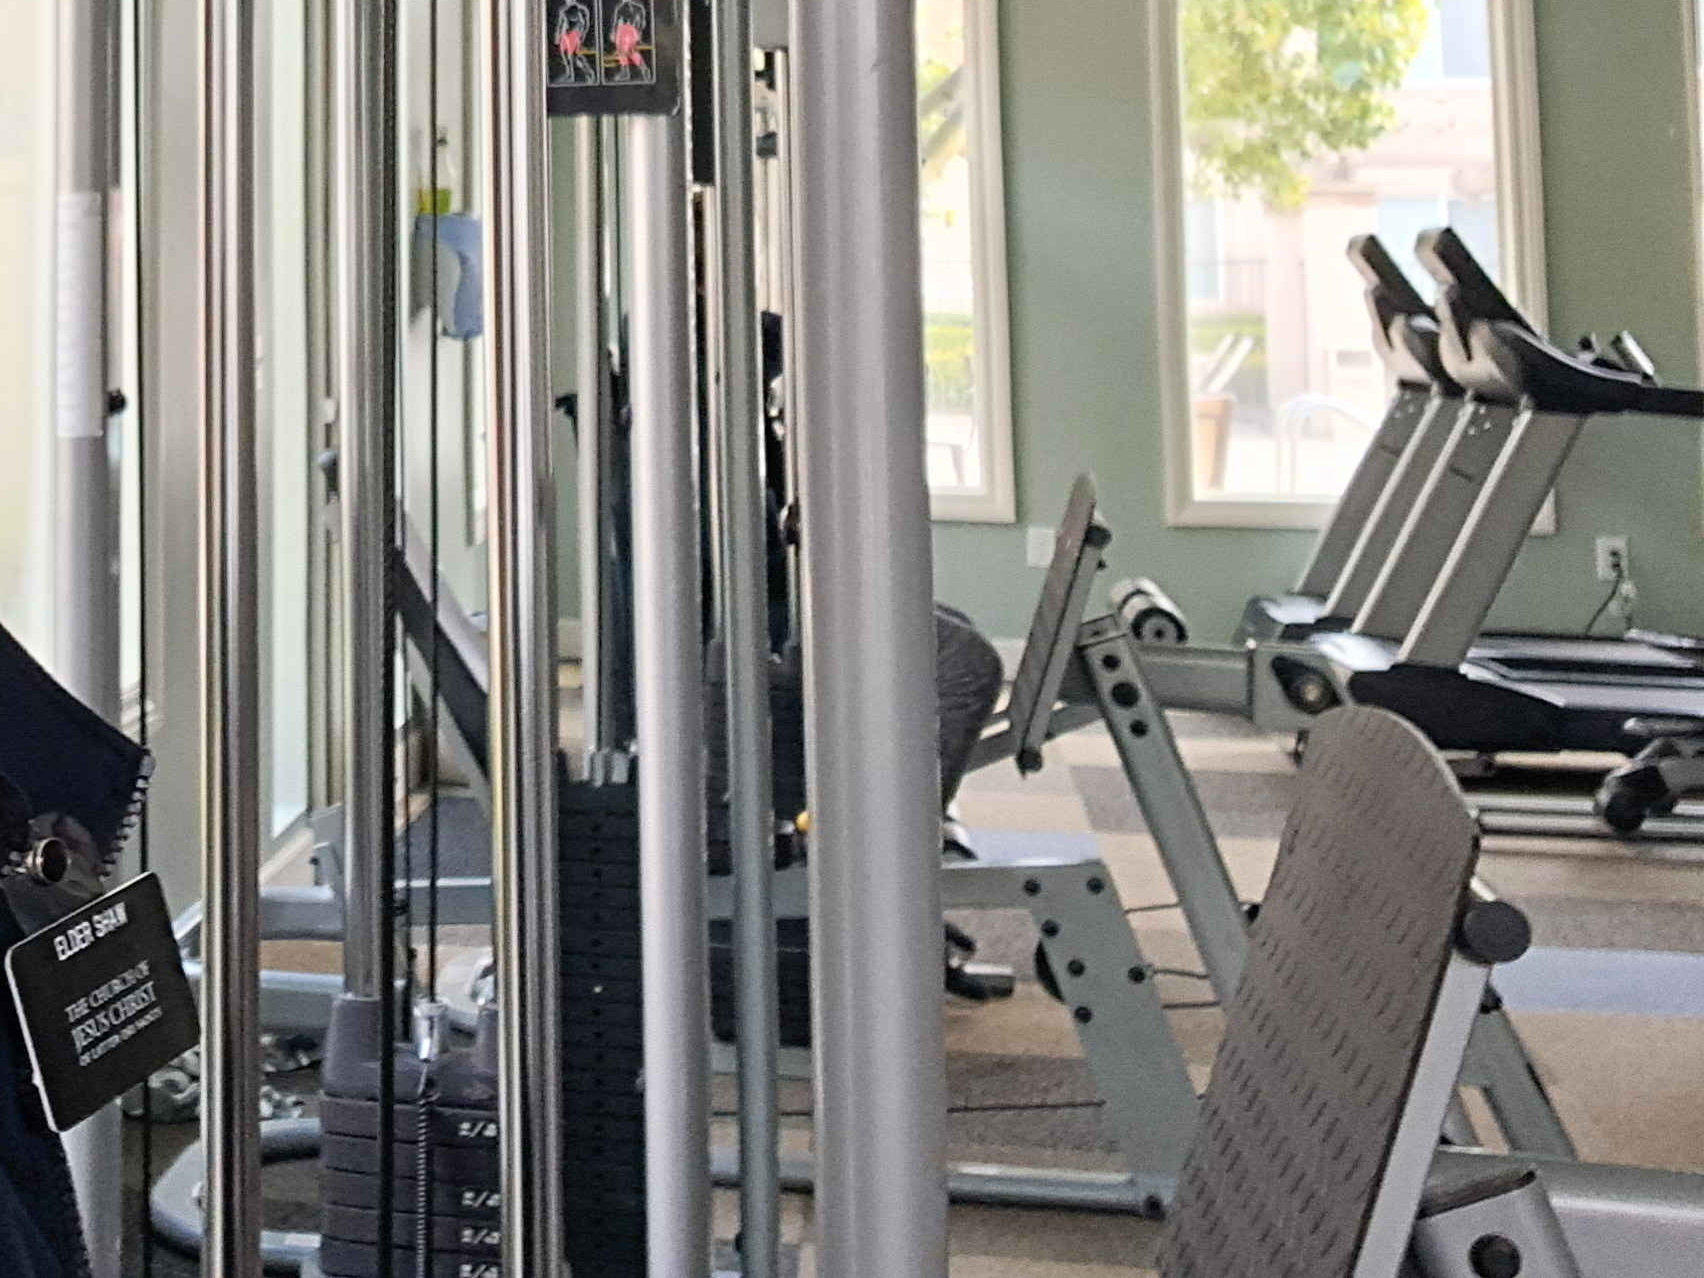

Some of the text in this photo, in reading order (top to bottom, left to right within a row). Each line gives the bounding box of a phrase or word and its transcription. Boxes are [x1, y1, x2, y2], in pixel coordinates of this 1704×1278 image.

[53, 920, 95, 962] ELDER
[64, 996, 90, 1023] THE
[88, 969, 135, 1008] CHURCH
[71, 980, 157, 1054] JESUS CHRIST
